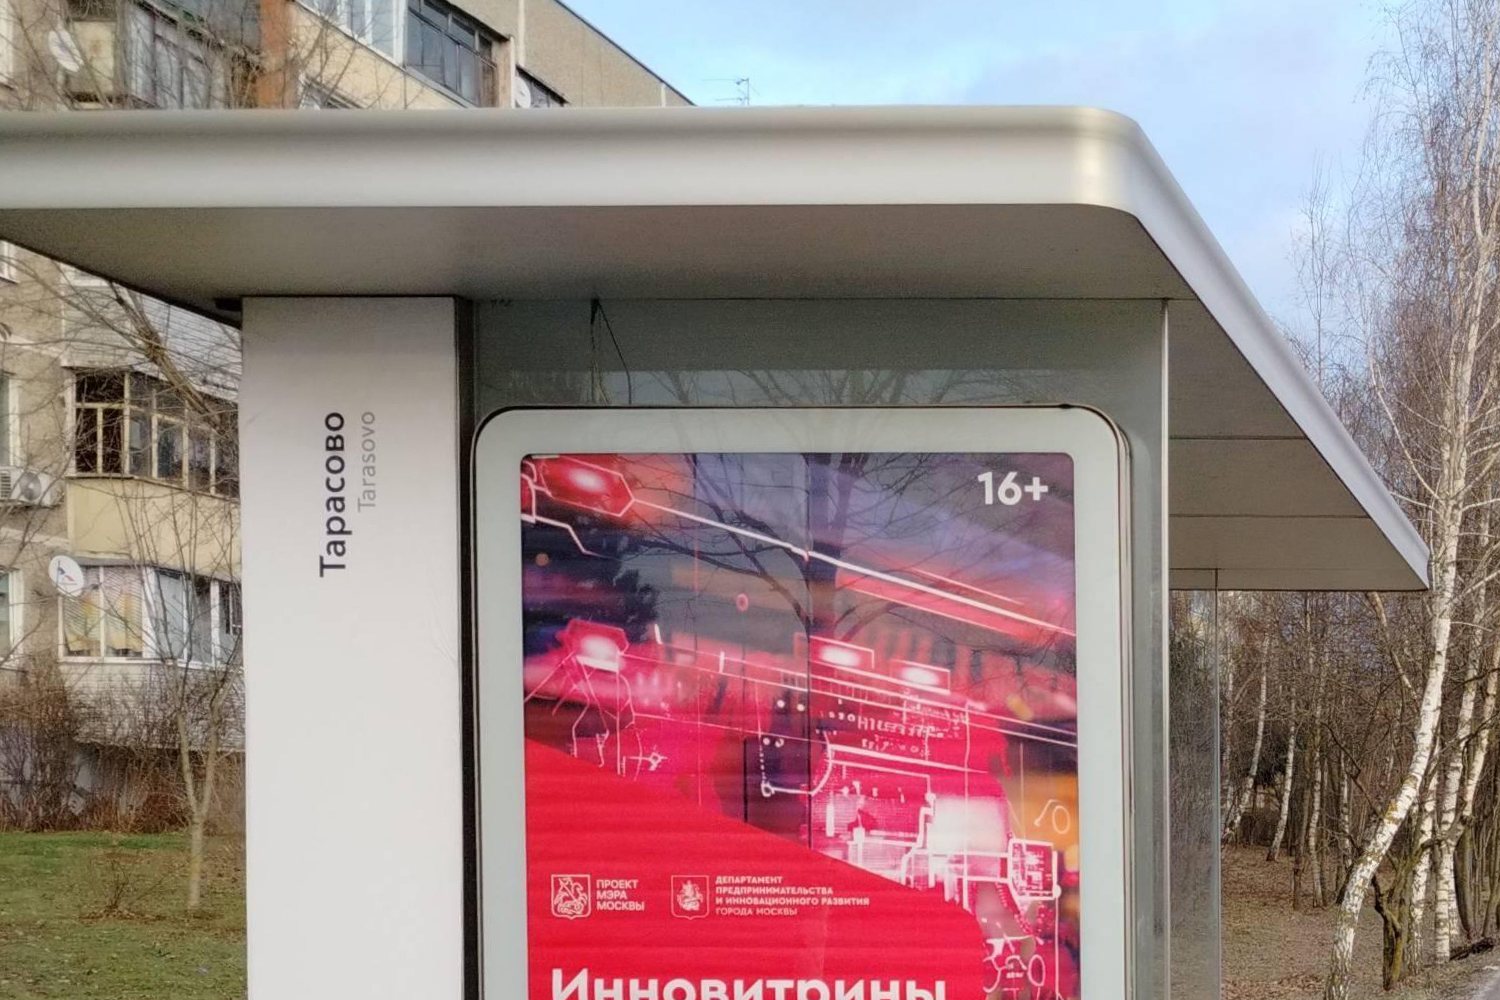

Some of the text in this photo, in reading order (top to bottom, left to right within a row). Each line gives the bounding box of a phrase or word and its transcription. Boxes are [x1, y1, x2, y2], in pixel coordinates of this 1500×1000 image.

[357, 411, 376, 512] Tarasovo
[977, 471, 1049, 506] 16+
[319, 412, 352, 577] Тарасово
[596, 879, 639, 889] ПРОЕКТ
[715, 876, 783, 884] ДЕПАРТАМЕНТ
[596, 890, 628, 900] МЭРА
[715, 886, 833, 895] ПРЕДПРИНИМАТЕЛЬСТВА
[596, 901, 645, 911] МОСКВЫ
[715, 897, 870, 907] И ИННОВАЦИОННОГО РАЗВИТИЯ
[715, 907, 798, 916] ГОРОДА МОСКВЫ
